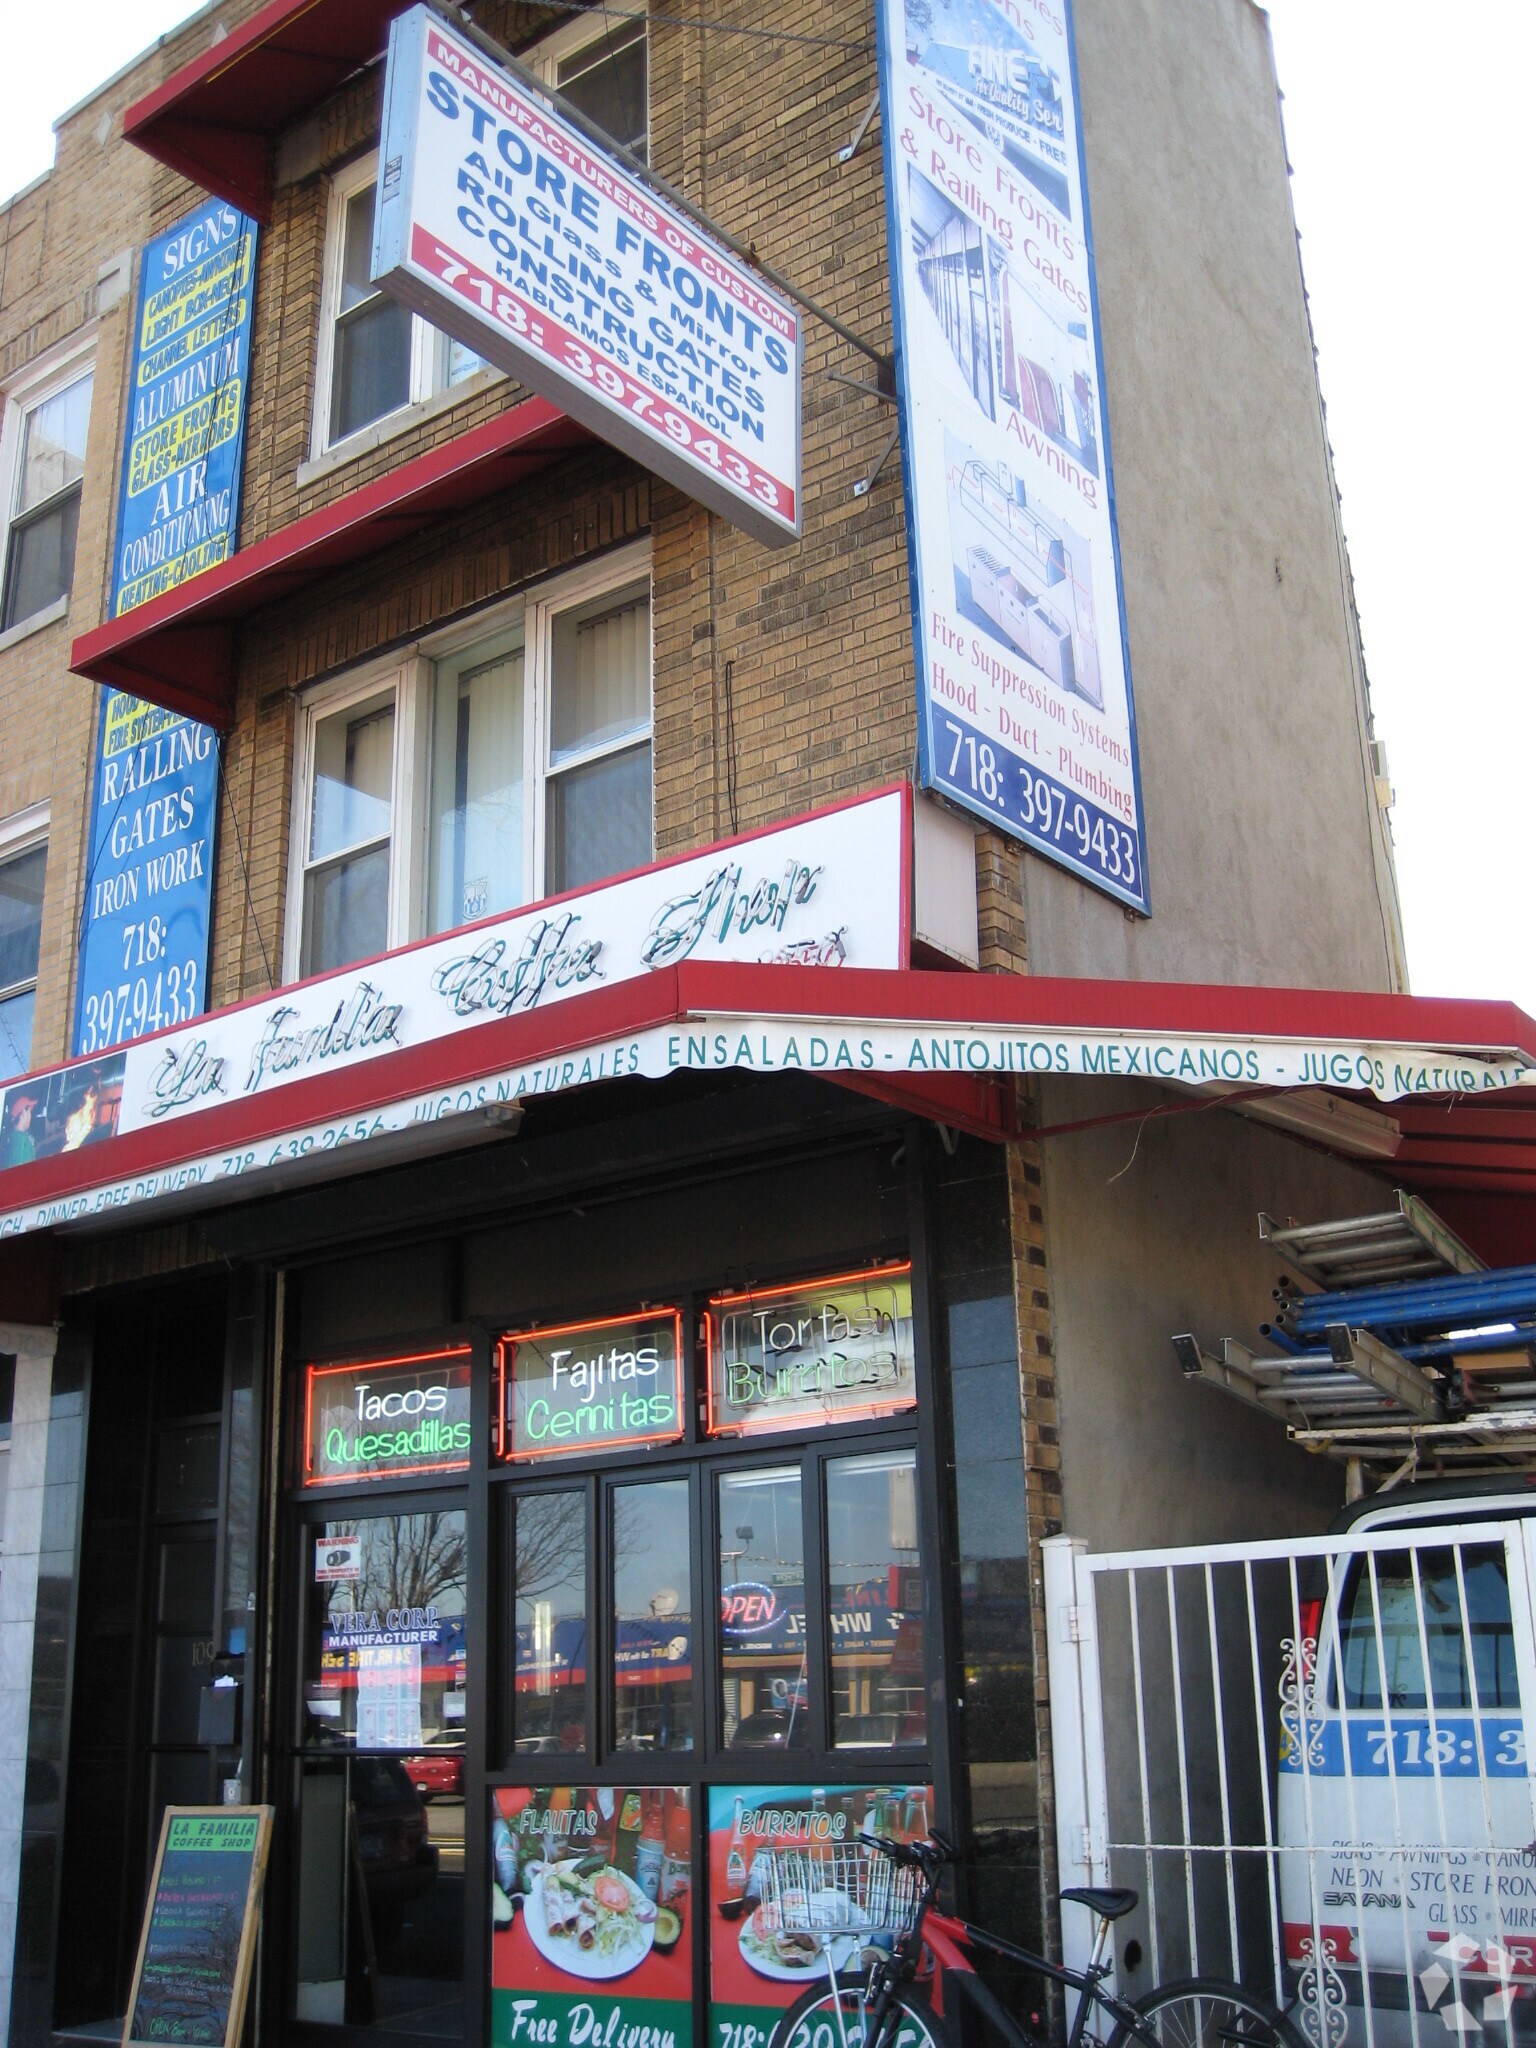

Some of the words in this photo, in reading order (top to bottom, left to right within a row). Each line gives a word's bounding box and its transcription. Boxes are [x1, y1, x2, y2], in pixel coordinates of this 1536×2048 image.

[990, 83, 1029, 121] Quality
[995, 115, 1031, 143] PRODUCE
[438, 46, 657, 232] MANUFACTURERS
[665, 230, 693, 257] OF
[700, 254, 790, 334] CUSTOM
[909, 86, 983, 173] Store
[996, 166, 1074, 262] Fronts
[163, 204, 236, 280] SIGNS
[426, 71, 599, 233] STORE
[616, 218, 788, 375] FRONTS
[900, 128, 919, 160] &
[931, 150, 1014, 251] Railing
[1024, 238, 1088, 314] Gates
[457, 168, 634, 318] ROLLING
[649, 318, 764, 413] GATES
[465, 151, 513, 196] All
[527, 196, 622, 279] Glass
[635, 280, 657, 306] &
[670, 302, 761, 382] Mirror
[143, 335, 189, 382] CHANNEL
[193, 300, 241, 347] LETTERS
[146, 306, 182, 347] LIGHT
[457, 205, 764, 443] CONSTRUCTION
[496, 262, 629, 367] HABLAMOS
[638, 364, 732, 440] ESPAÑOL
[134, 337, 240, 436] ALUMINUM
[435, 247, 543, 344] 718:
[563, 341, 779, 508] 397-9433
[132, 411, 234, 493] GLASS-MIRRORS
[134, 420, 178, 468] STORE
[182, 384, 238, 438] FRONTS
[1006, 411, 1098, 510] Awning
[151, 460, 207, 526] AIR
[122, 489, 229, 581] CONDITIONING
[120, 536, 224, 613] HEATING-COOLING
[931, 611, 965, 658] Fire
[971, 645, 1067, 728] Suppression
[1071, 707, 1130, 768] Systems
[102, 723, 212, 805] RALLING
[108, 723, 129, 754] FIRE
[931, 660, 977, 716] Hood
[999, 706, 1039, 755] Duct
[1058, 745, 1133, 821] Plumbing
[112, 785, 194, 859] GATES
[945, 720, 1005, 808] 718:
[1019, 766, 1136, 885] 397-9433
[93, 867, 140, 919] IRON
[146, 839, 204, 898] WORK
[122, 916, 167, 971] 718:
[431, 912, 607, 1019] Coffee
[640, 861, 826, 970] Shop
[84, 959, 197, 1055] 397-9433
[497, 1043, 639, 1100] NATURALES
[908, 1038, 1069, 1073] ANTOJITOS
[1080, 1043, 1260, 1080] MEXICANOS
[1296, 1052, 1385, 1090] JUGOS
[753, 1303, 877, 1355] Tortas
[355, 1384, 448, 1421] Tacos
[551, 1346, 660, 1402] Fajitas
[728, 1352, 896, 1405] Burritos
[326, 1418, 471, 1466] Quesadillas
[526, 1392, 675, 1440] Cemitas
[318, 1536, 359, 1547] WARNING
[329, 1611, 381, 1634] VERA
[386, 1607, 441, 1630] CORP.
[329, 1632, 438, 1647] MANUFACTURER
[721, 1596, 775, 1623] OPEN
[1367, 1729, 1473, 1764] 718:
[173, 1822, 189, 1835] LA
[199, 1822, 255, 1836] FAMILIA
[173, 1838, 213, 1847] COFFEE
[221, 1838, 251, 1848] SHOP
[520, 1809, 598, 1836] FLAUTAS
[739, 1810, 847, 1840] BURRITOS
[1331, 1841, 1373, 1861] SIGNS
[1331, 1868, 1383, 1887] NEON
[1411, 1872, 1474, 1893] STORE
[1429, 1903, 1477, 1924] GLASS
[512, 2000, 557, 2044] Free
[568, 2003, 675, 2048] Delivery
